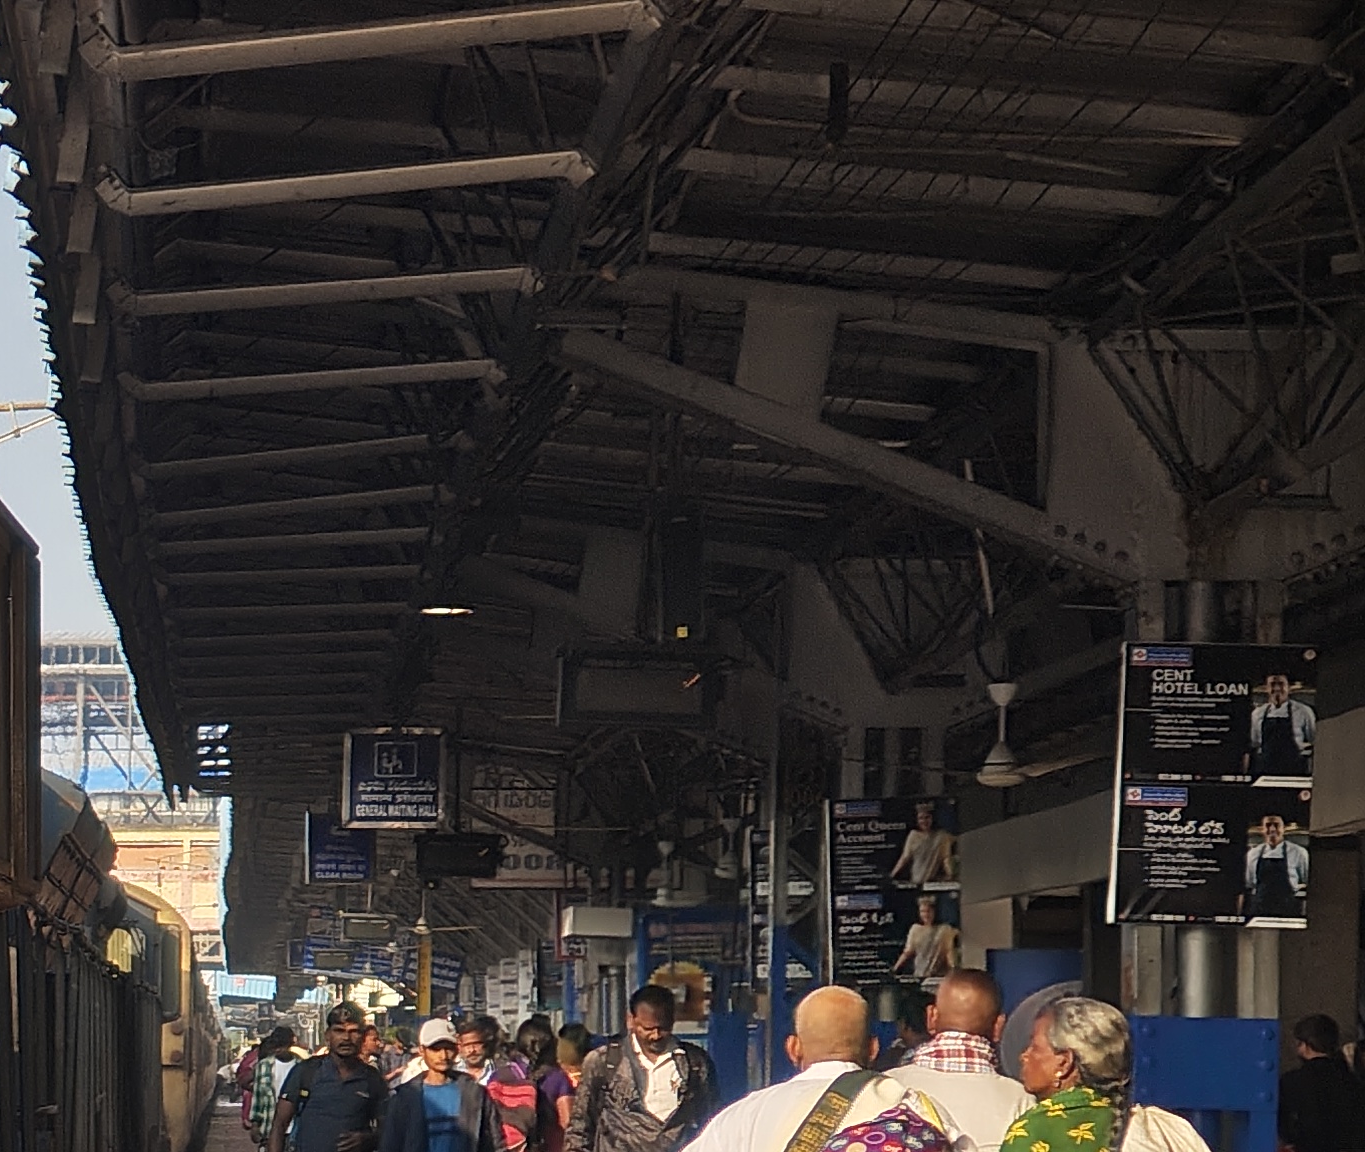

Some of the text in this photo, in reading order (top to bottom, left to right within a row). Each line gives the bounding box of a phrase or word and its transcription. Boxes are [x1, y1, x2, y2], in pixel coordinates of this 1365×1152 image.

[1152, 669, 1195, 681] CENT
[1152, 682, 1249, 696] HOTEL LOAN
[355, 804, 387, 817] GENERAL
[388, 805, 417, 817] WAITING
